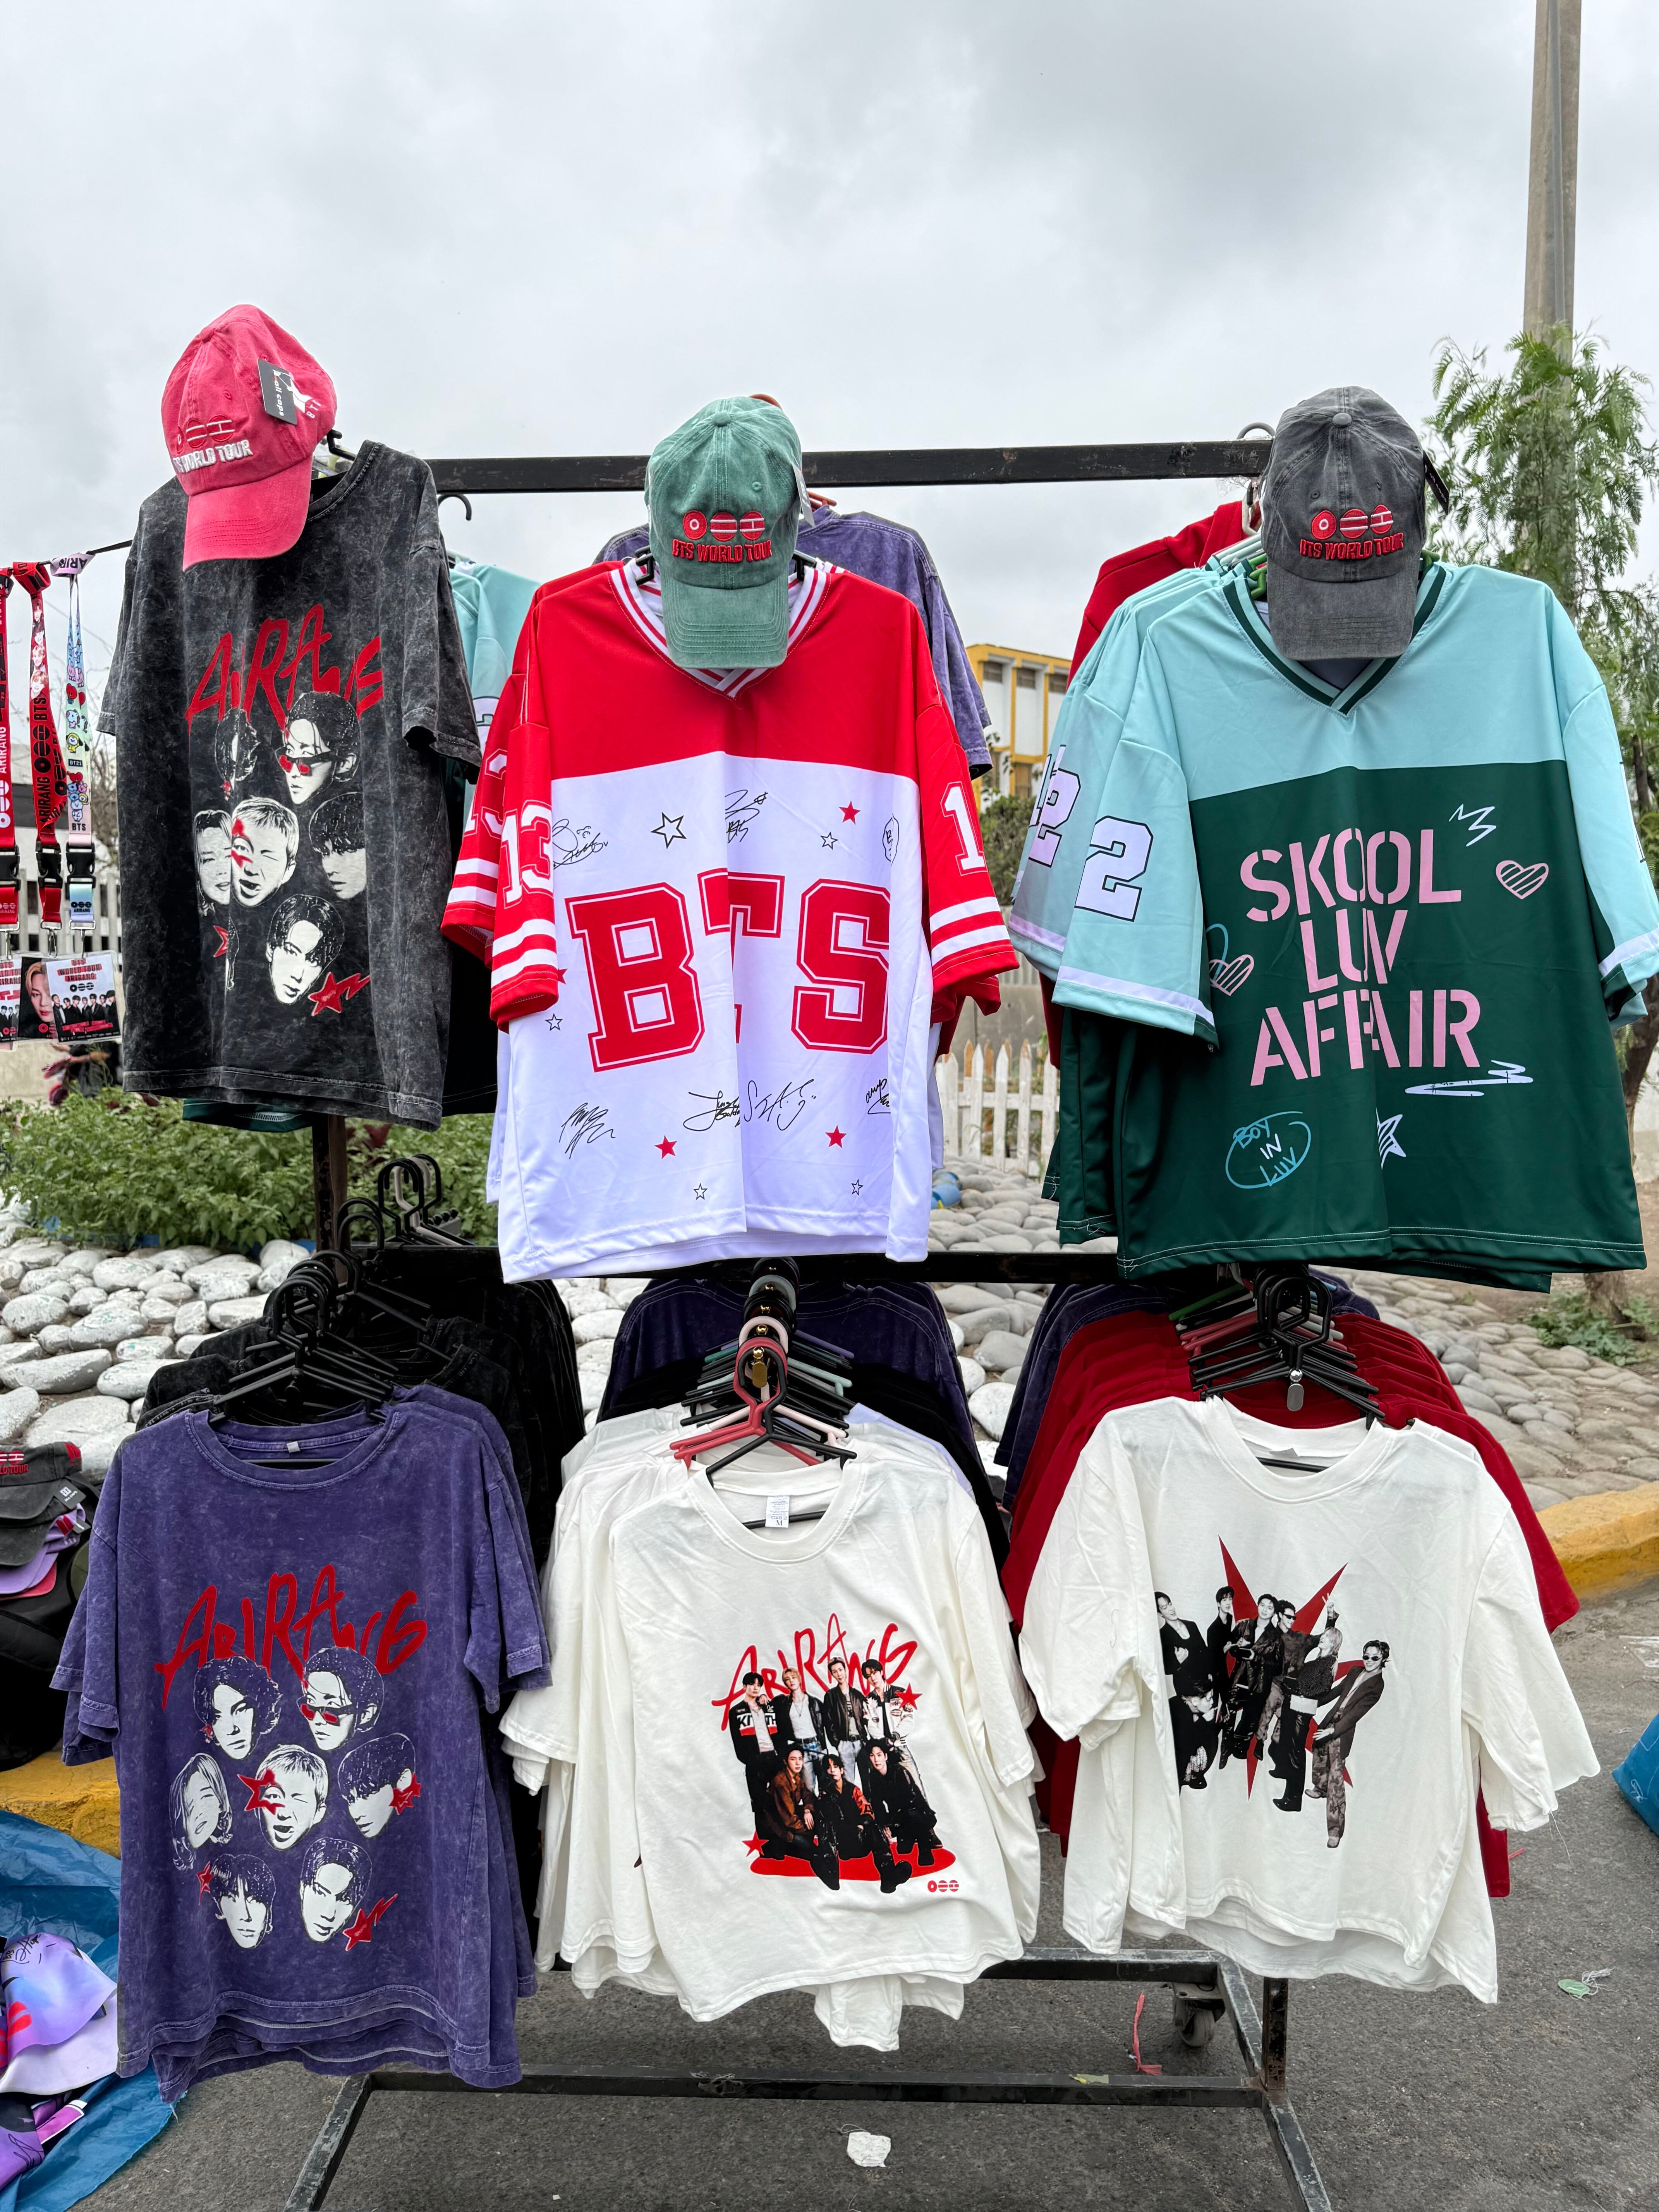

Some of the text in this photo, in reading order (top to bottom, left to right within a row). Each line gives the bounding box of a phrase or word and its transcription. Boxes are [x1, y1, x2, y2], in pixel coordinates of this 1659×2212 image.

[274, 380, 284, 417] all caps
[180, 448, 216, 473] WORLD
[215, 440, 253, 462] TOUR
[672, 539, 773, 563] BTS WORLD TOUR
[1299, 532, 1404, 561] BTS WORLD TOUR
[33, 697, 47, 721] BTS
[37, 776, 50, 823] ARIRANG
[72, 823, 86, 831] BTS
[501, 800, 553, 909] 13
[1240, 828, 1462, 922] SKOOL
[1300, 908, 1408, 993] LUV
[564, 867, 891, 1073] BTS
[1250, 989, 1480, 1086] AFFAIR
[1233, 1117, 1270, 1149] BOY
[1259, 1133, 1282, 1159] IN
[1259, 1146, 1297, 1187] LUV
[9, 1463, 29, 1475] TOUR
